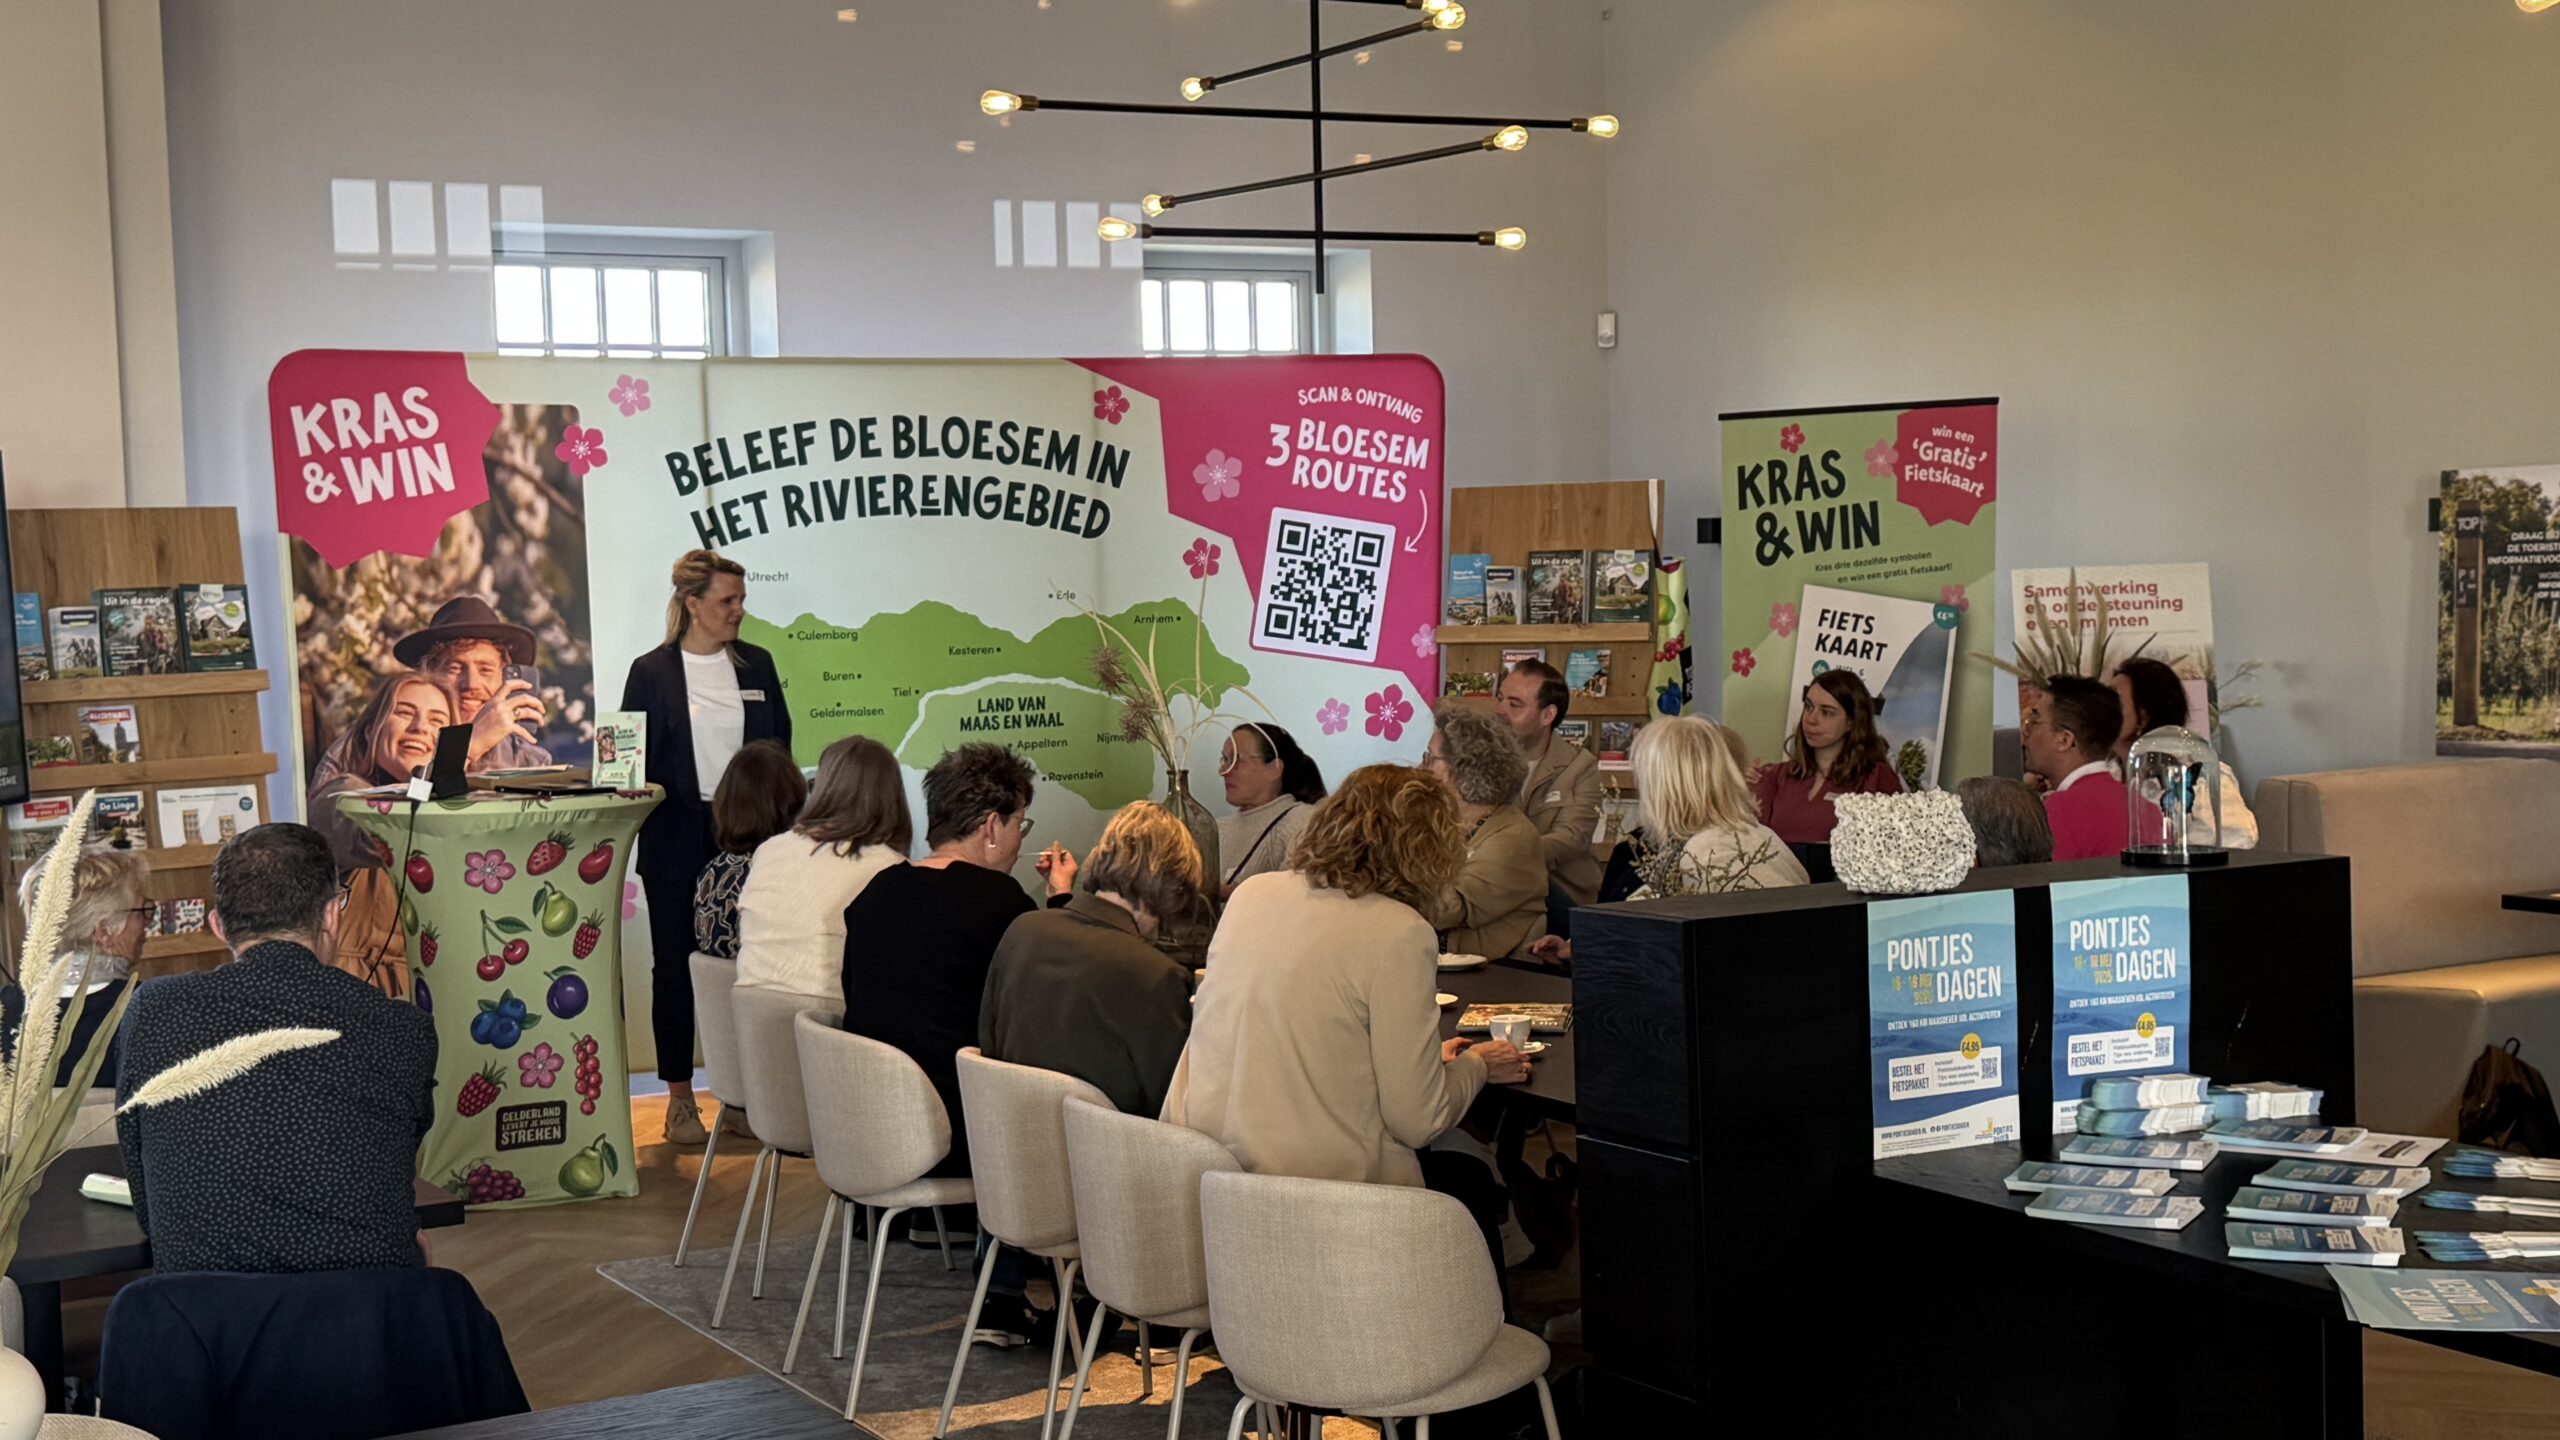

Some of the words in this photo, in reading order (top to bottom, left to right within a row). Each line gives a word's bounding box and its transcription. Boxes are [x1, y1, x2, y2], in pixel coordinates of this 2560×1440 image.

[1298, 386, 1338, 406] SCAN
[1341, 387, 1352, 402] &
[1356, 388, 1423, 424] ONTVANG
[290, 386, 439, 457] KRAS
[1932, 425, 1952, 438] win
[1954, 430, 1975, 444] een
[1265, 423, 1291, 466] 3
[1297, 417, 1430, 470] BLOESEM
[665, 421, 817, 497] BELEEF
[831, 416, 882, 462] DE
[893, 415, 1081, 476] BLOESEM
[1086, 440, 1131, 489] IN
[1292, 455, 1407, 503] ROUTES
[1737, 449, 1846, 511] KRAS
[1905, 464, 1985, 498] Fietskaart
[690, 490, 770, 550] HET
[781, 474, 1111, 540] RIVIERENGEBIED
[2457, 517, 2480, 531] TOP
[2507, 544, 2520, 553] DE
[1890, 551, 1932, 564] symbolen
[747, 571, 789, 582] Utrecht
[1849, 573, 1865, 582] win
[1883, 568, 1908, 580] gratis
[104, 597, 117, 606] Uit
[120, 596, 129, 605] in
[1134, 613, 1174, 624] Arnhem
[1818, 608, 1875, 635] FIETS
[797, 630, 858, 642] Culemborg
[948, 645, 994, 656] Kesteren
[1815, 632, 1888, 662] KAART
[823, 671, 855, 681] Buren
[892, 687, 912, 697] Tiel
[810, 706, 884, 718] Geldermalsen
[977, 697, 1014, 713] LAND
[1018, 695, 1046, 711] VAN
[960, 714, 1000, 732] MAAS
[1004, 714, 1022, 730] EN
[1025, 712, 1064, 728] WAAL
[1017, 738, 1068, 751] Appeltern
[1048, 769, 1103, 782] Ravenstein
[100, 802, 111, 811] De
[2069, 914, 2151, 952] PONTJES
[1887, 932, 1974, 972] PONTJES
[2115, 947, 2176, 984] DAGEN
[1936, 965, 2002, 1003] DAGEN
[2071, 1041, 2091, 1053] BESTEL
[2092, 1040, 2103, 1051] HET
[2071, 1054, 2106, 1068] FIETSPAKKET
[1892, 1064, 1913, 1078] BESTEL
[1914, 1063, 1925, 1075] HET
[1892, 1077, 1930, 1093] FIETSPAKKET
[503, 1106, 561, 1122] GELDERLAND
[501, 1126, 562, 1145] STREKEN
